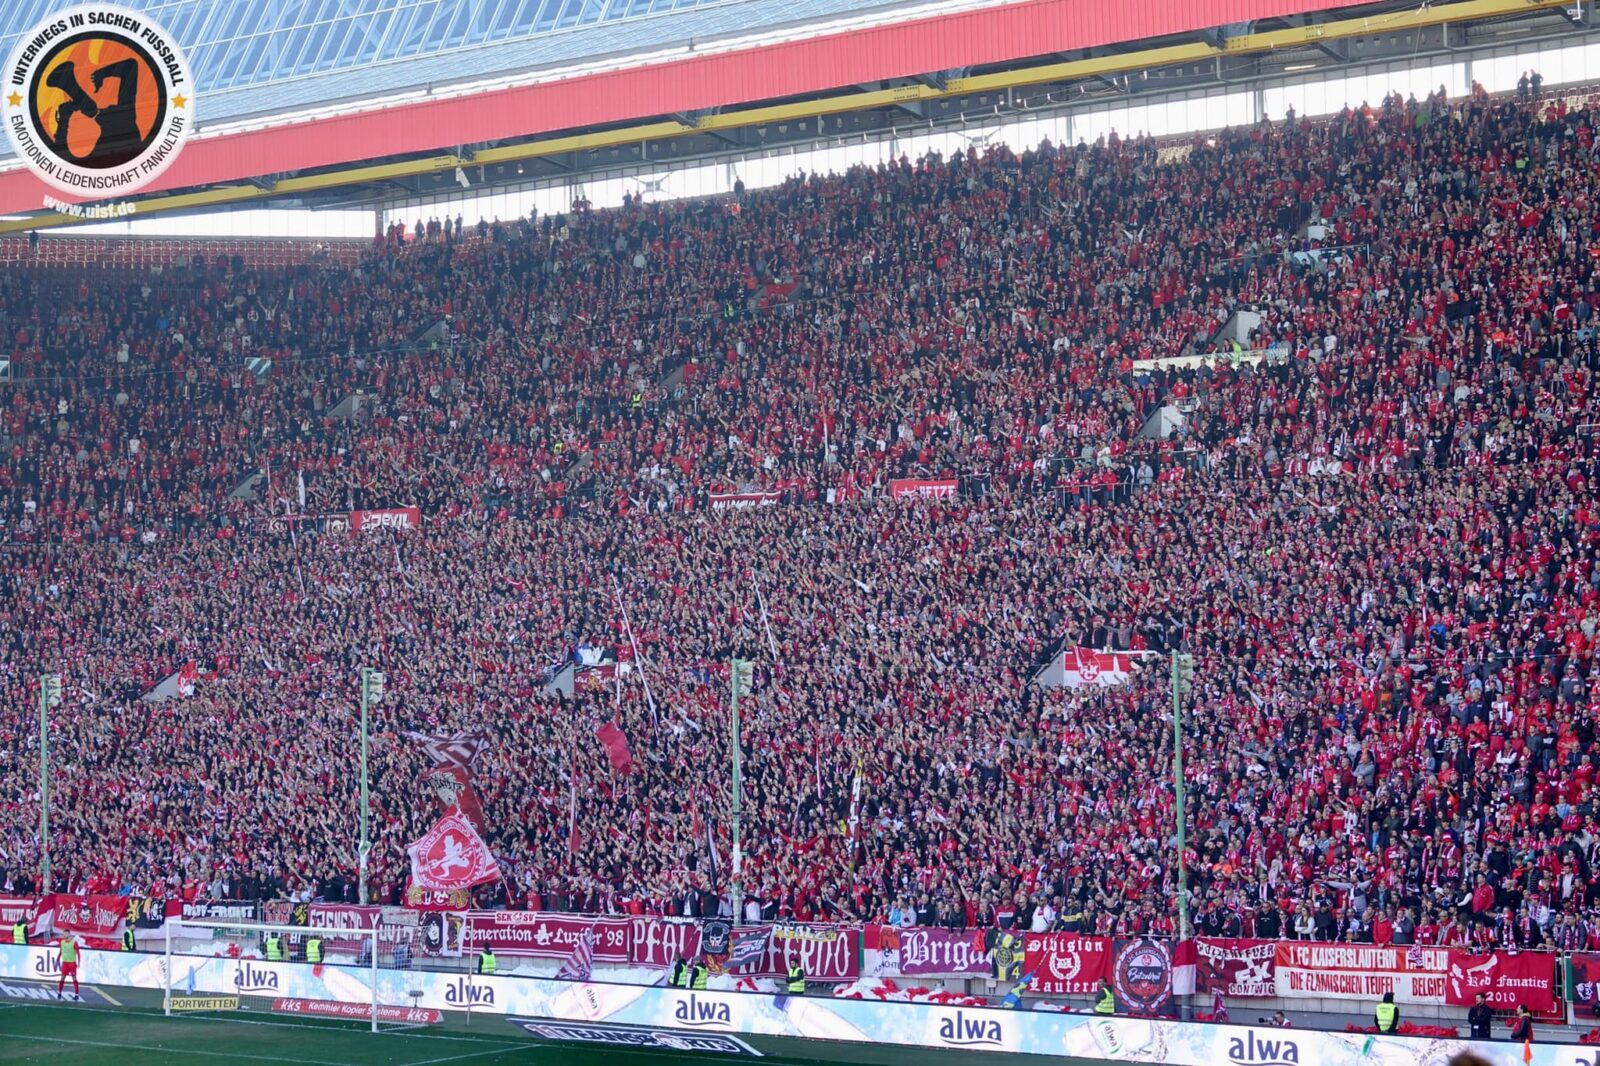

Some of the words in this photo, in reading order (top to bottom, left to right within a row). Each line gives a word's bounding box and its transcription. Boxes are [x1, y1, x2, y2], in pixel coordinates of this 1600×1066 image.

[496, 912, 512, 922] SEK
[522, 912, 534, 922] SV
[1027, 938, 1104, 953] Division
[1312, 947, 1396, 969] KAISERSLAUTERN
[1406, 950, 1449, 970] FCLU
[234, 962, 279, 988] alwa
[1467, 975, 1491, 988] Red
[1496, 975, 1548, 989] Fanatics
[445, 976, 495, 1005] alwa
[1030, 977, 1099, 993] Lautern
[1486, 991, 1516, 1003] 2010
[367, 1007, 400, 1017] Ssteme
[675, 993, 730, 1022] alwa
[940, 1010, 1002, 1041] alwa
[1228, 1029, 1300, 1063] alwa
